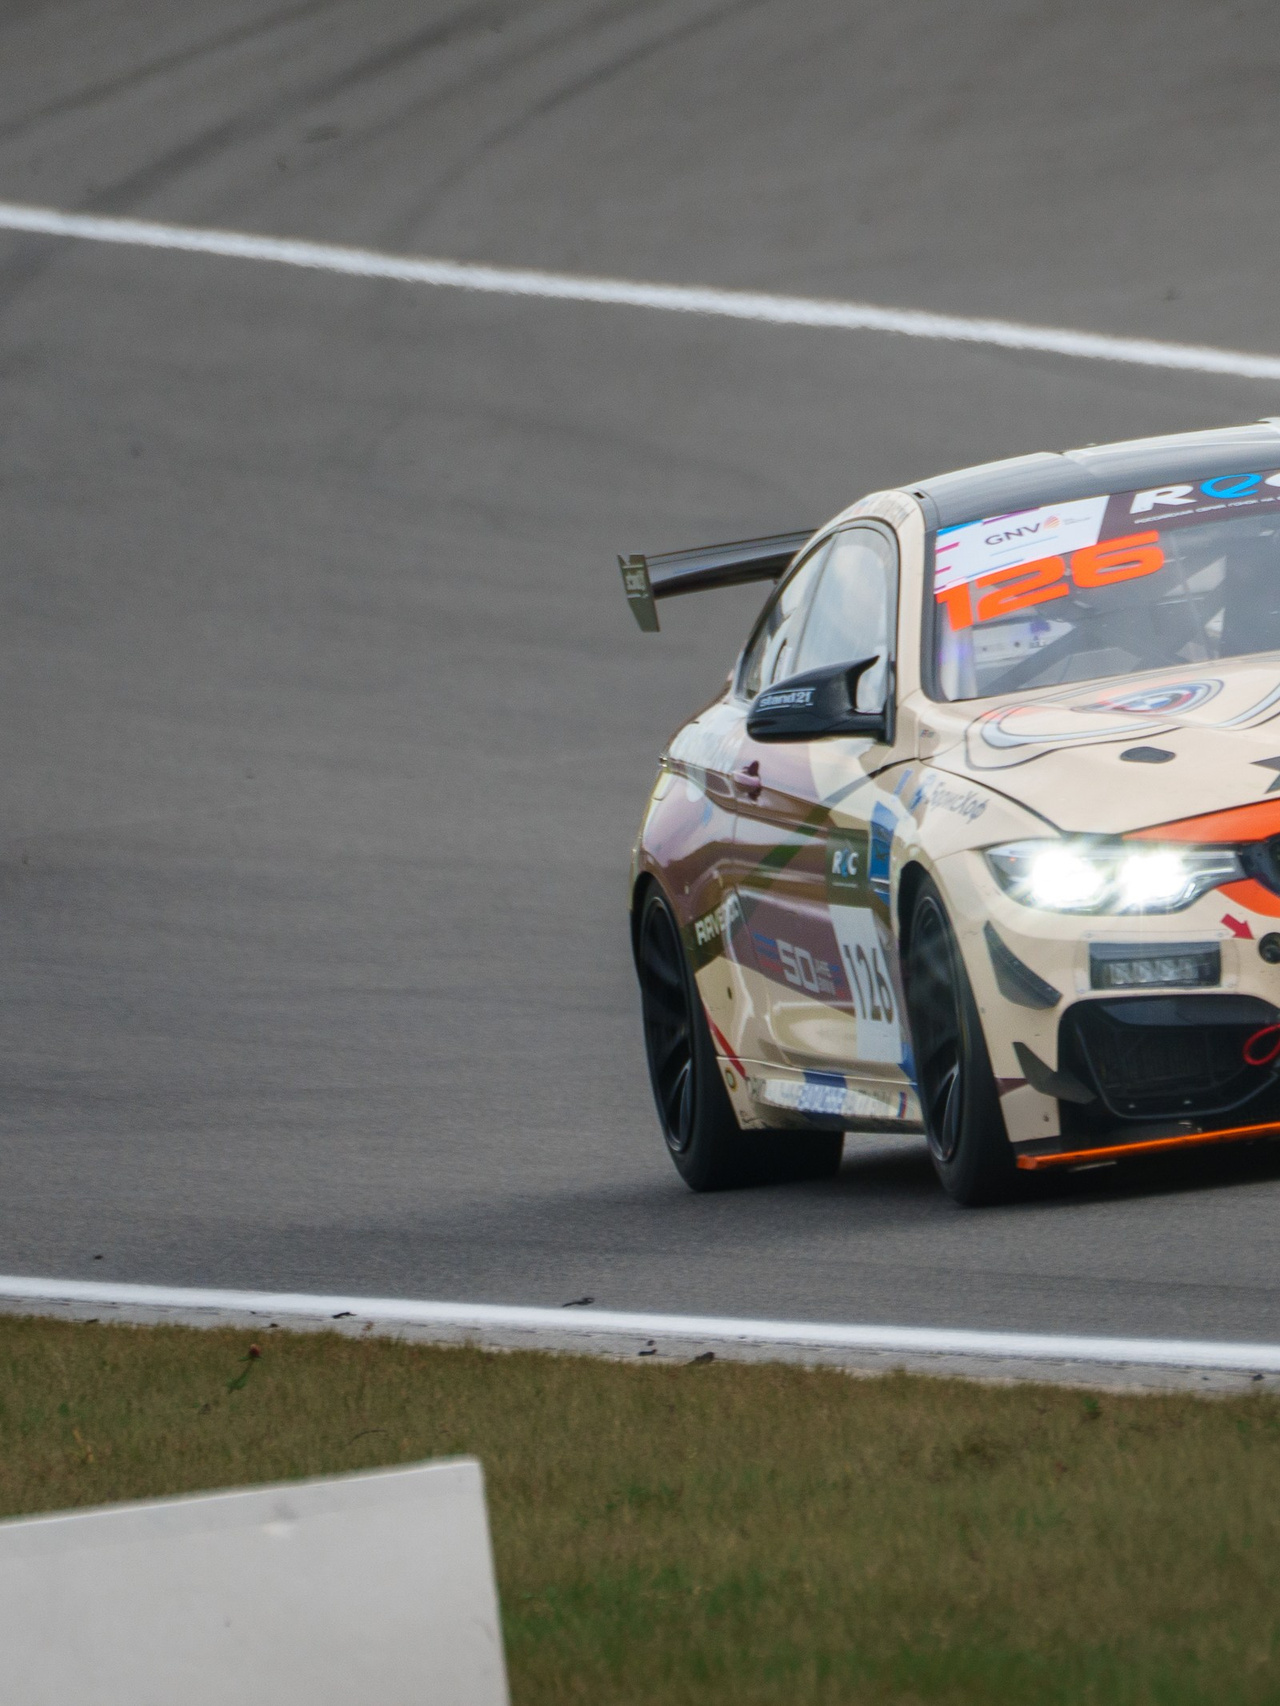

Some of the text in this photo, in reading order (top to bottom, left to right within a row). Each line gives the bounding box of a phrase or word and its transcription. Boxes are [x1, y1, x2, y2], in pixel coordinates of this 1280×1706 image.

[984, 522, 1041, 546] GNV
[936, 530, 1165, 633] 126
[842, 944, 894, 1024] 126
